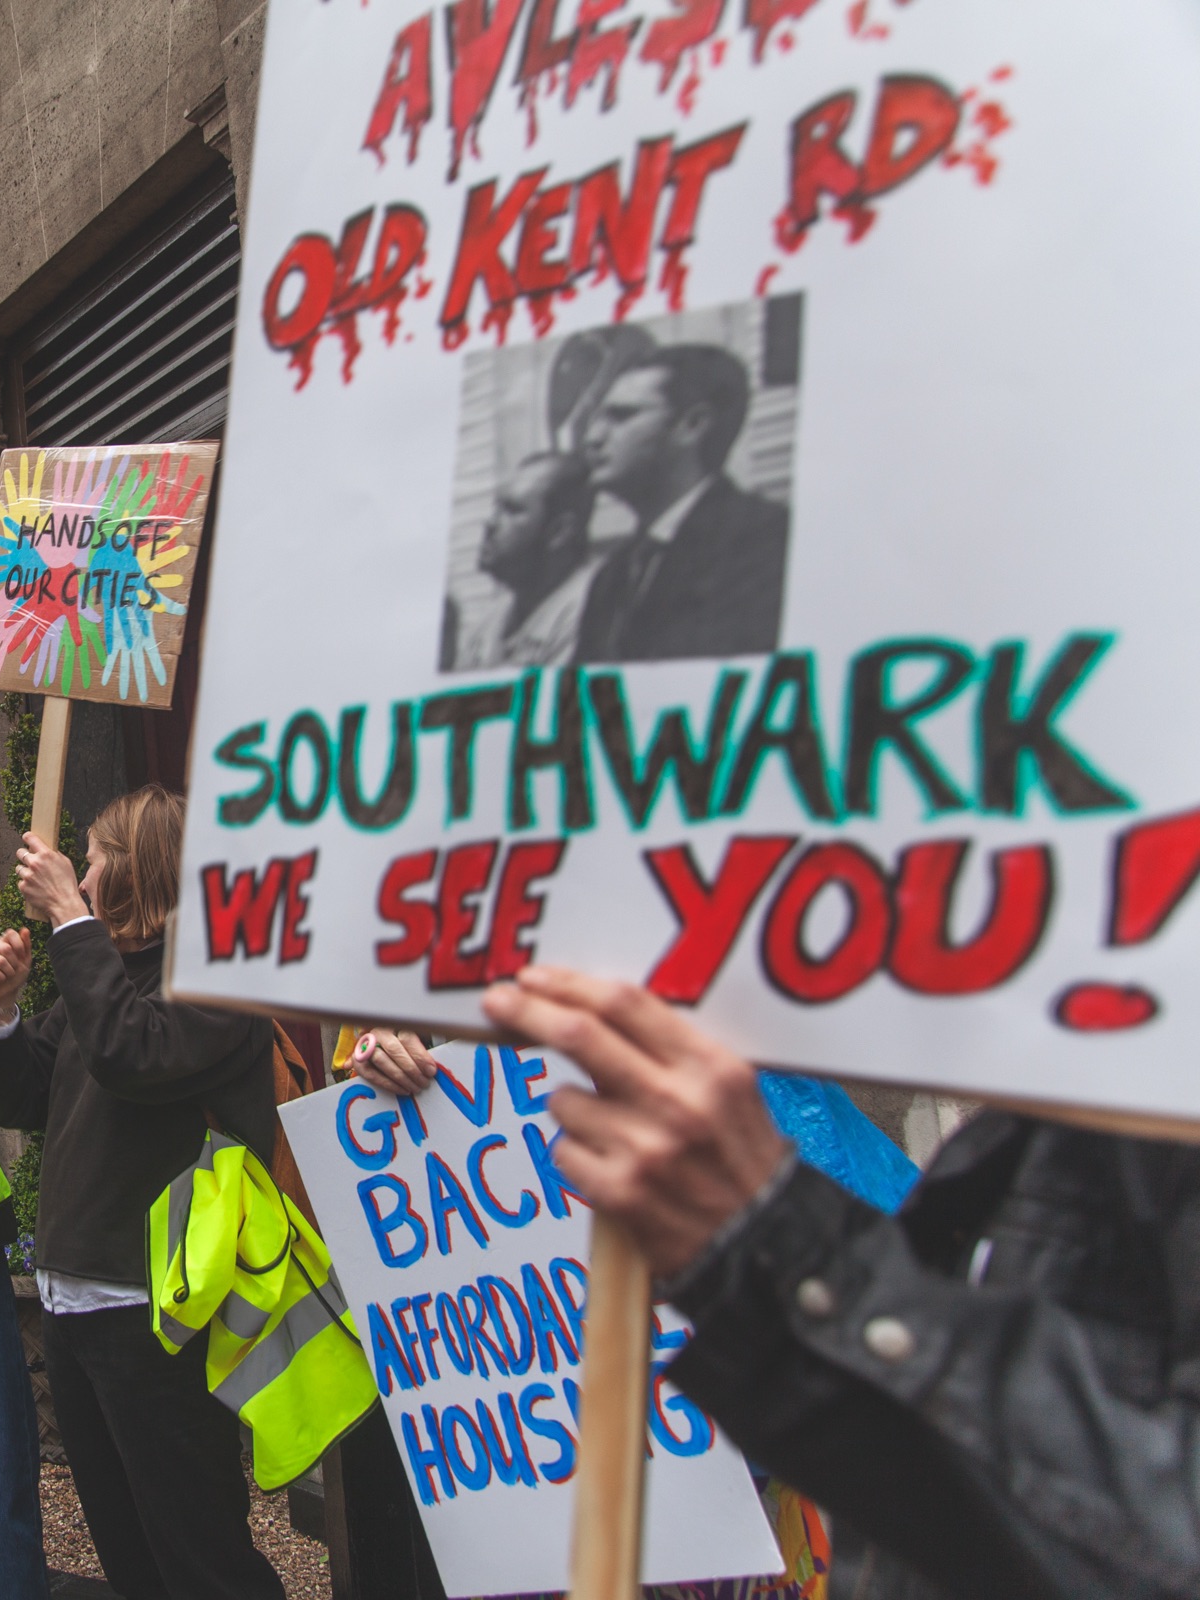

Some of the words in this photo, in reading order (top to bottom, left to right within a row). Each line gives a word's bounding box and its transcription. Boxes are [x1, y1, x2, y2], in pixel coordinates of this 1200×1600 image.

[263, 204, 432, 384] OLD
[440, 121, 750, 345] KENT
[784, 72, 996, 248] RD
[4, 564, 56, 605] OUR
[60, 568, 162, 610] CITIES
[214, 630, 1140, 836] SOUTHWARK
[201, 848, 319, 966] WE
[375, 836, 570, 990] SEE
[642, 806, 1200, 1032] YOU!
[336, 1042, 548, 1171] GIVE
[356, 1122, 596, 1268] BACK
[366, 1256, 695, 1398] AFFORDAB
[400, 1360, 716, 1507] HOUSG
